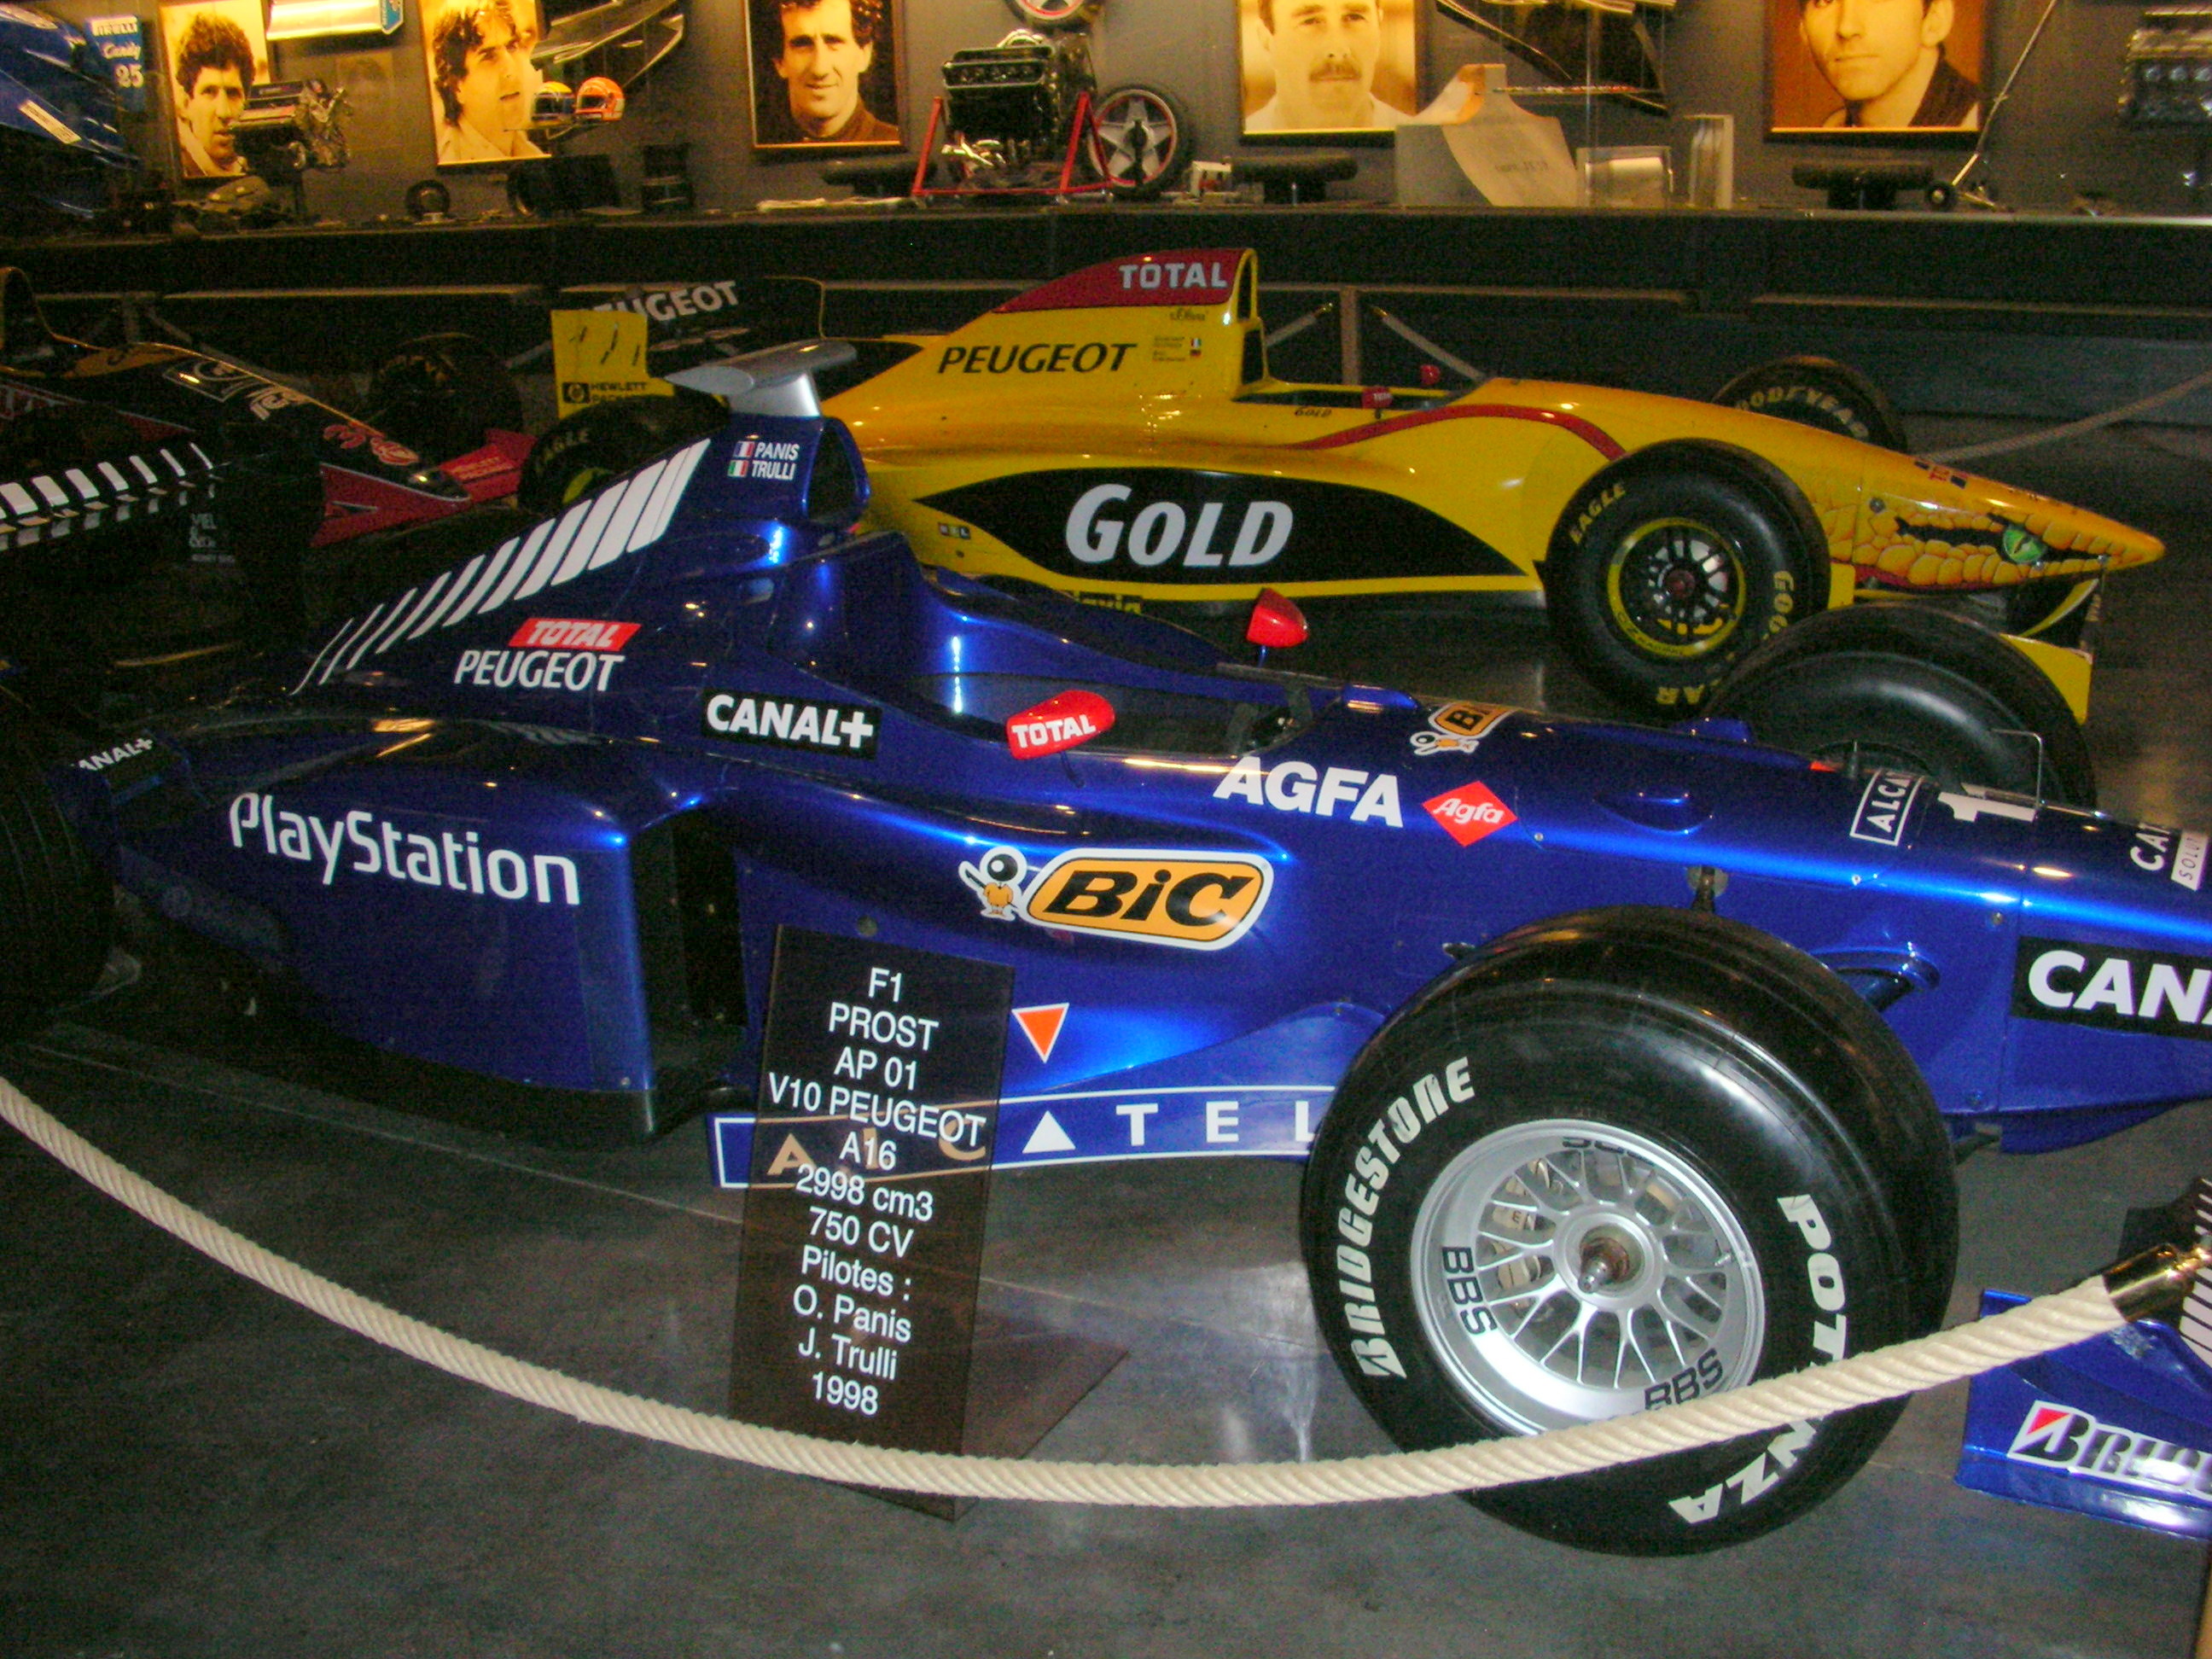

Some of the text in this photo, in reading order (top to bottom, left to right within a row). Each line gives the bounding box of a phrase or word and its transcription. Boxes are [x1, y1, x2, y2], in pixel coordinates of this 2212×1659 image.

[1120, 263, 1227, 288] TOTAL
[938, 343, 1137, 373] PEUGEOT
[751, 460, 795, 481] TRULLI
[754, 441, 800, 462] PANIS
[1066, 484, 1293, 567] GOLD
[1569, 483, 1626, 544] EAGLE
[527, 621, 620, 647] TOTAL
[454, 650, 626, 691] PEUGEOT
[707, 695, 874, 748] CANAL+
[1011, 714, 1097, 749] TOTAL
[71, 738, 154, 771] ANAL+
[1213, 756, 1404, 828] AGFA
[1433, 798, 1505, 824] Agfa
[229, 792, 581, 906] PlayStation
[868, 967, 903, 1004] F1
[2029, 950, 2212, 1024] CAN
[829, 1001, 939, 1052] PROST
[834, 1045, 917, 1091] AP 01
[769, 1072, 987, 1147] V10 PEUGEOT
[839, 1130, 897, 1172] A16
[795, 1163, 934, 1222] 2998 cm3
[1337, 1057, 1476, 1379] BRIDGESTONE
[808, 1205, 915, 1259] 750 CV
[800, 1244, 894, 1297] Pilotes
[1442, 1246, 1498, 1335] BBS
[793, 1285, 912, 1344] O. Panis
[798, 1327, 897, 1381] J. Trulli
[1668, 1195, 1848, 1524] POTNZA
[812, 1369, 879, 1415] 1998
